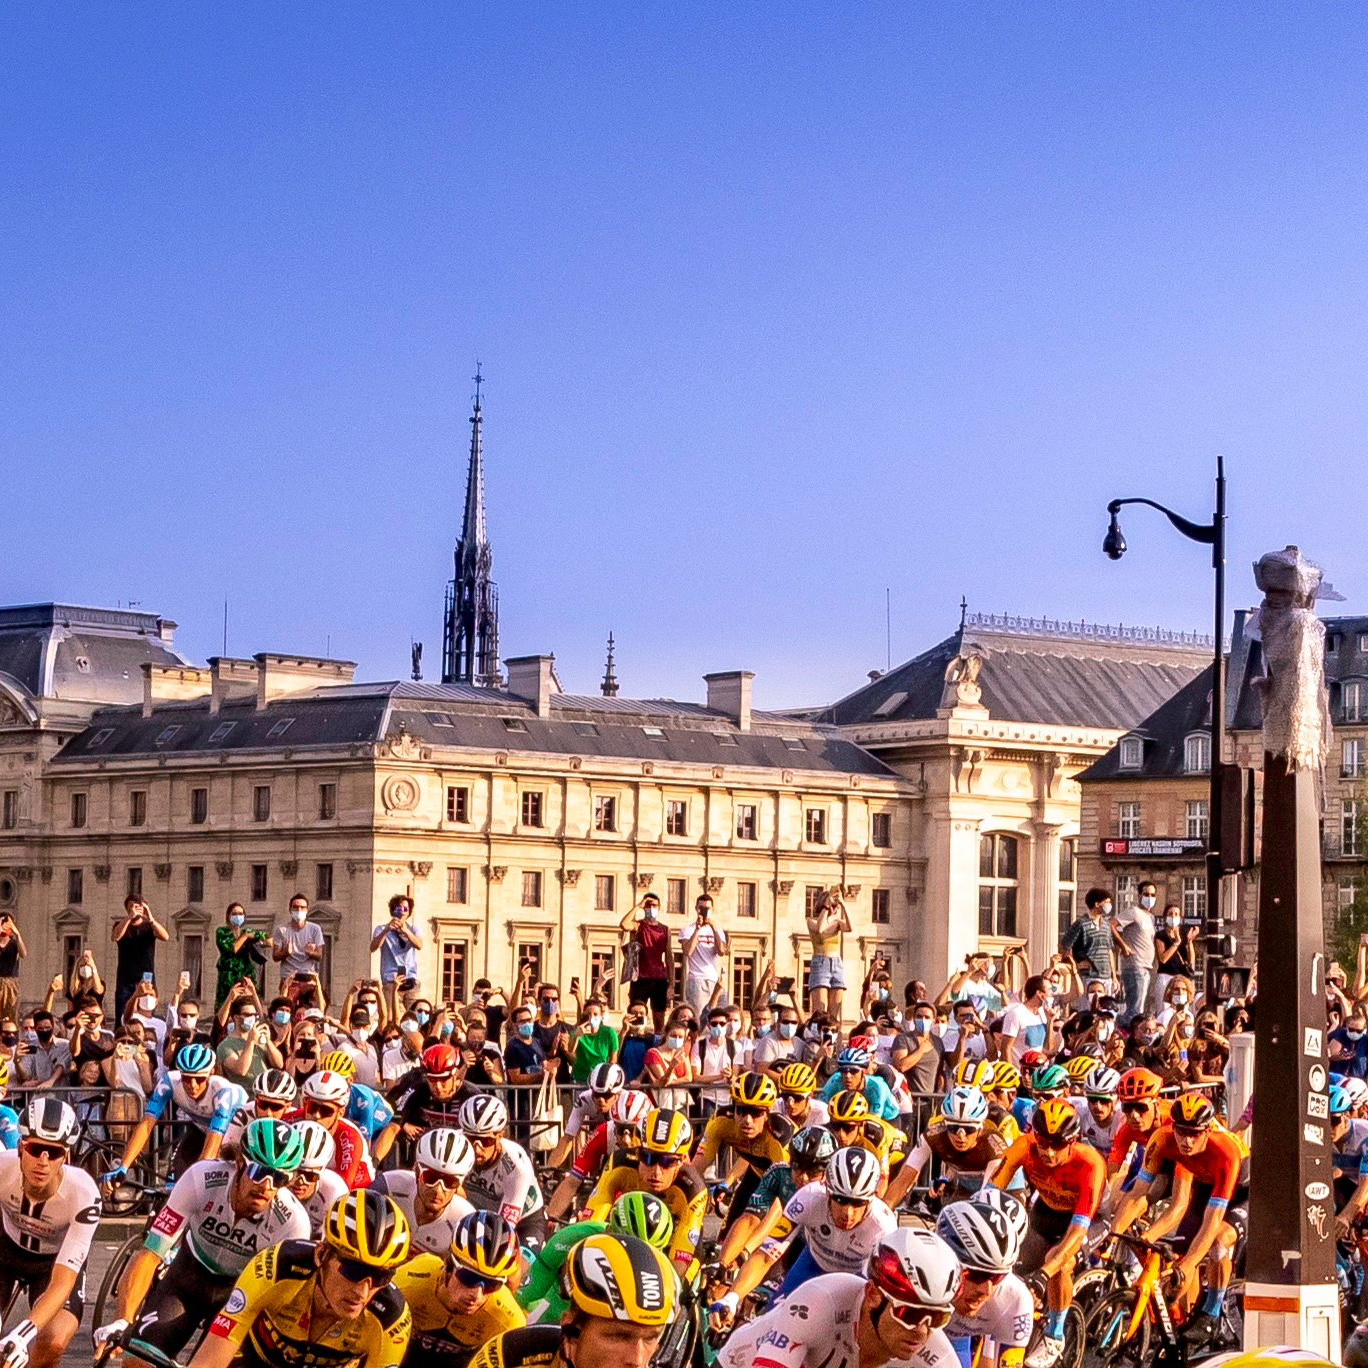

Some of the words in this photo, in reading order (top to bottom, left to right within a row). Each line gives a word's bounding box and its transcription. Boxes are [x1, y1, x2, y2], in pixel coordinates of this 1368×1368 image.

[204, 1171, 229, 1180] BORA
[202, 1217, 257, 1251] BORA
[595, 1257, 625, 1311] LAZER
[904, 1258, 920, 1287] MET
[640, 1271, 660, 1308] TONY
[215, 1318, 231, 1330] MA
